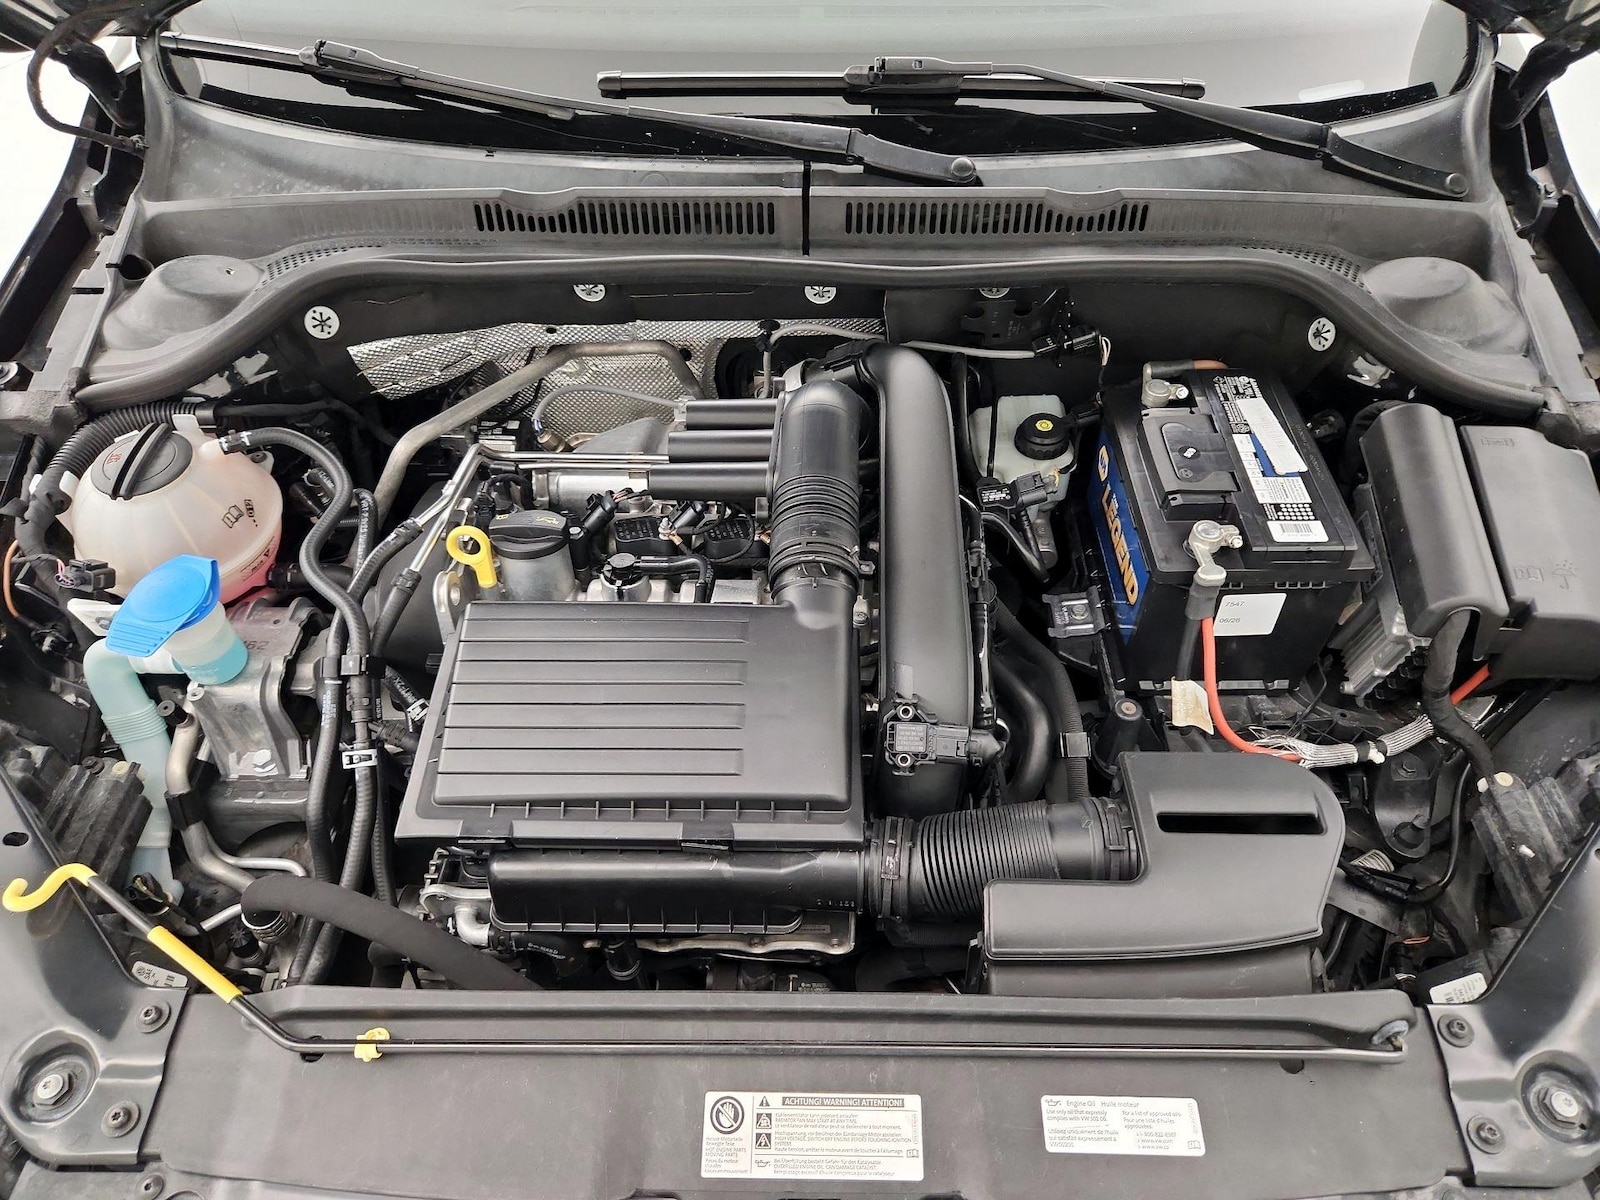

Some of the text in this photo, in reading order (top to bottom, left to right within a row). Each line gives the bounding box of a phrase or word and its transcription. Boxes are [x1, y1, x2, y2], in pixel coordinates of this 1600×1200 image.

[1102, 481, 1139, 605] LEGEND
[784, 1097, 904, 1107] ACHTUNG! WARNING! ATTENTION!
[1066, 1100, 1086, 1108] Engine
